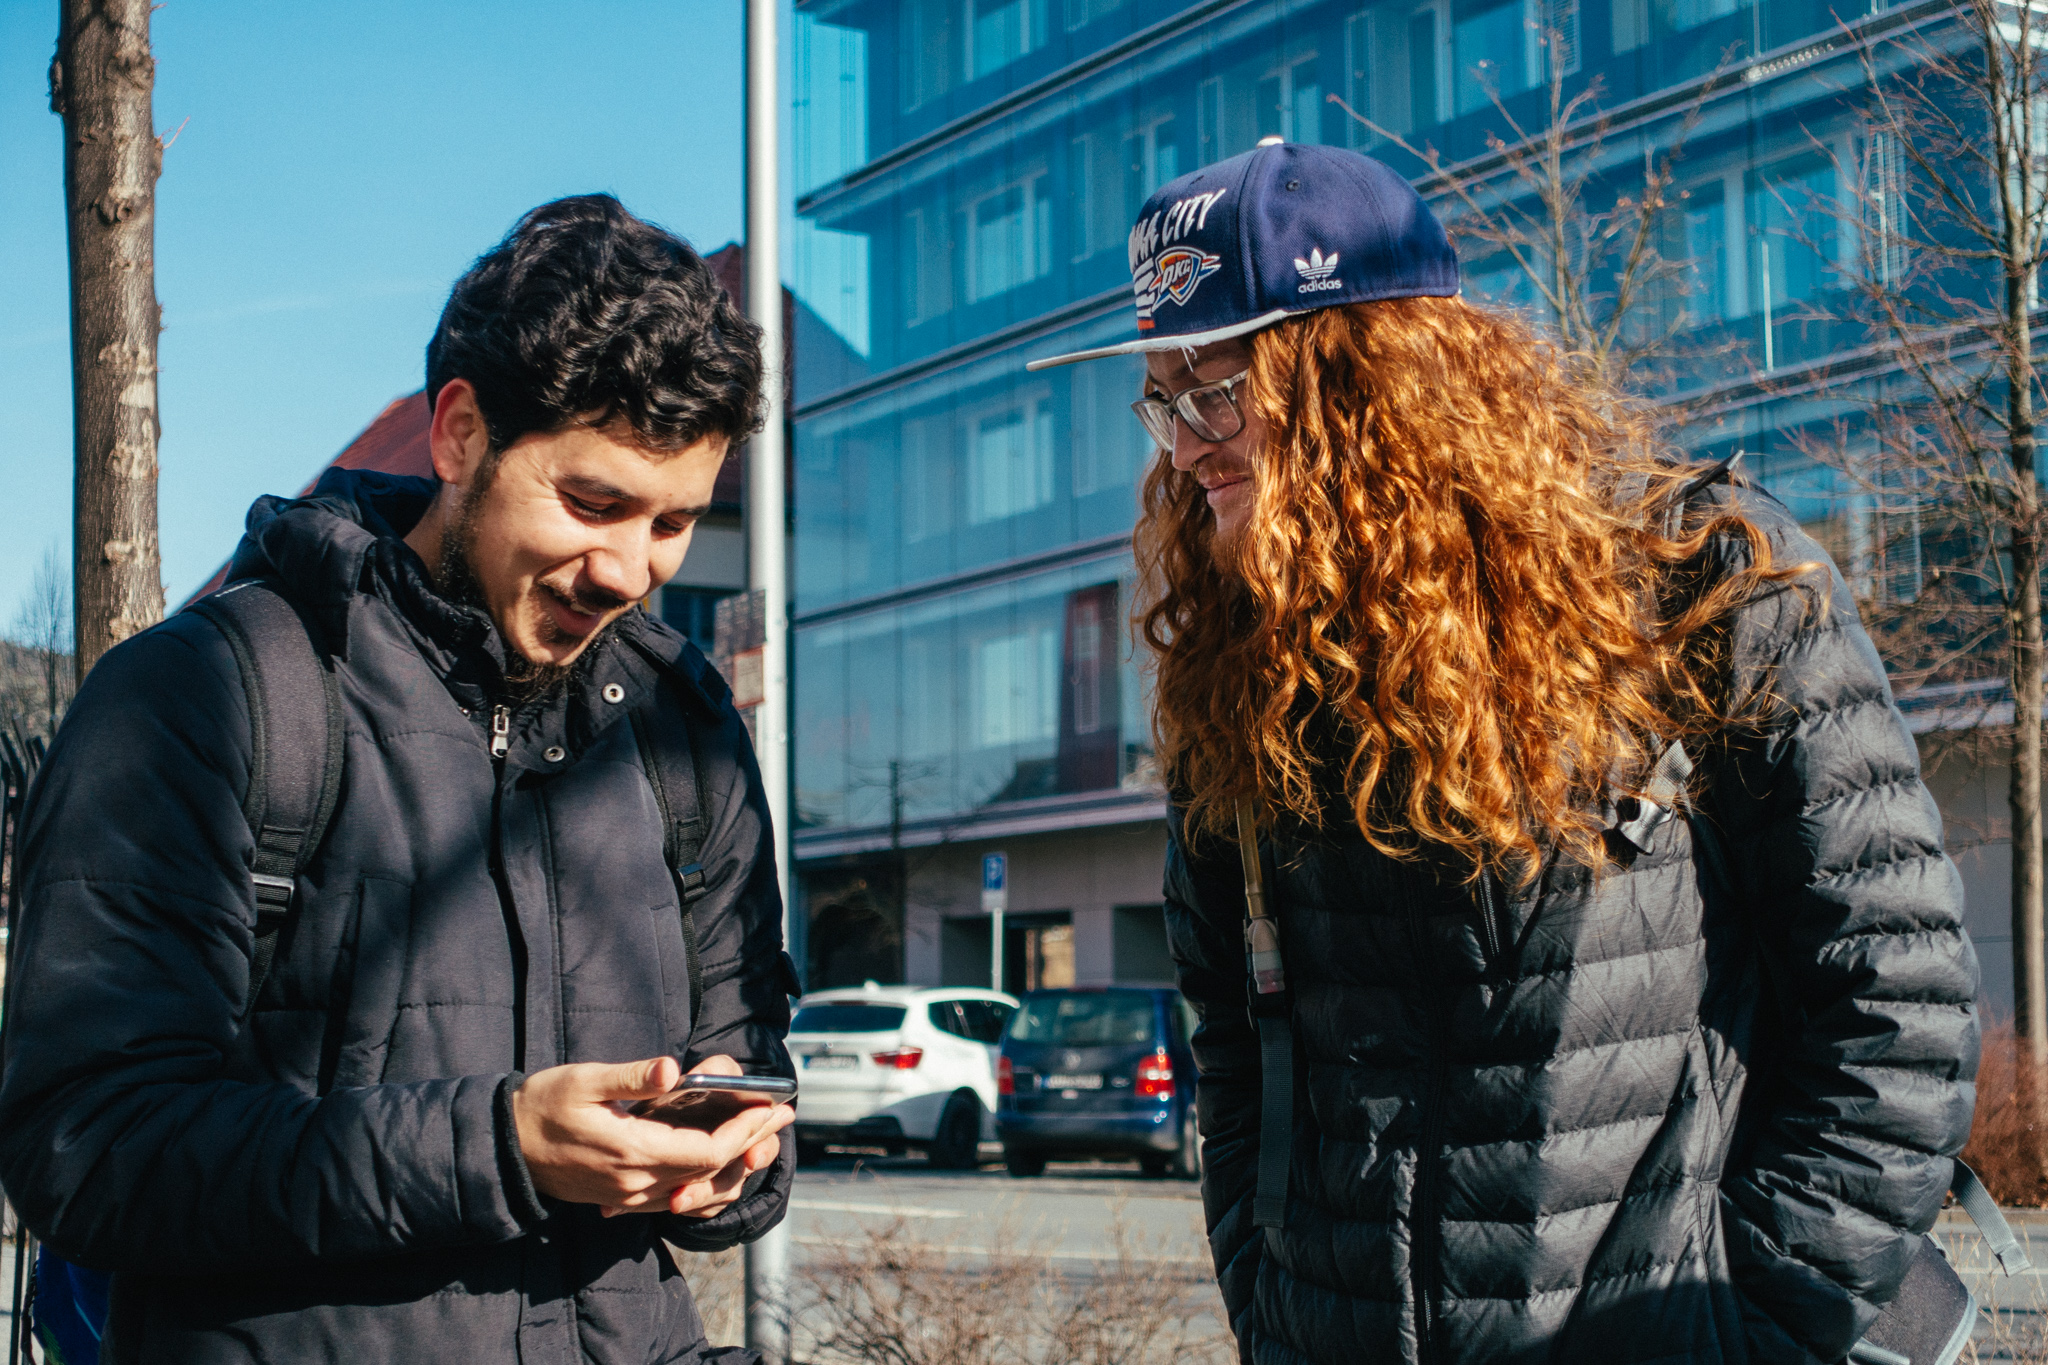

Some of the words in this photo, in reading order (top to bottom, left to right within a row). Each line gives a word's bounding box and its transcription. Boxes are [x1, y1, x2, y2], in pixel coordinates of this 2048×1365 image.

[1161, 188, 1226, 247] CITY
[1159, 258, 1191, 293] OKC
[1298, 278, 1342, 294] adidas
